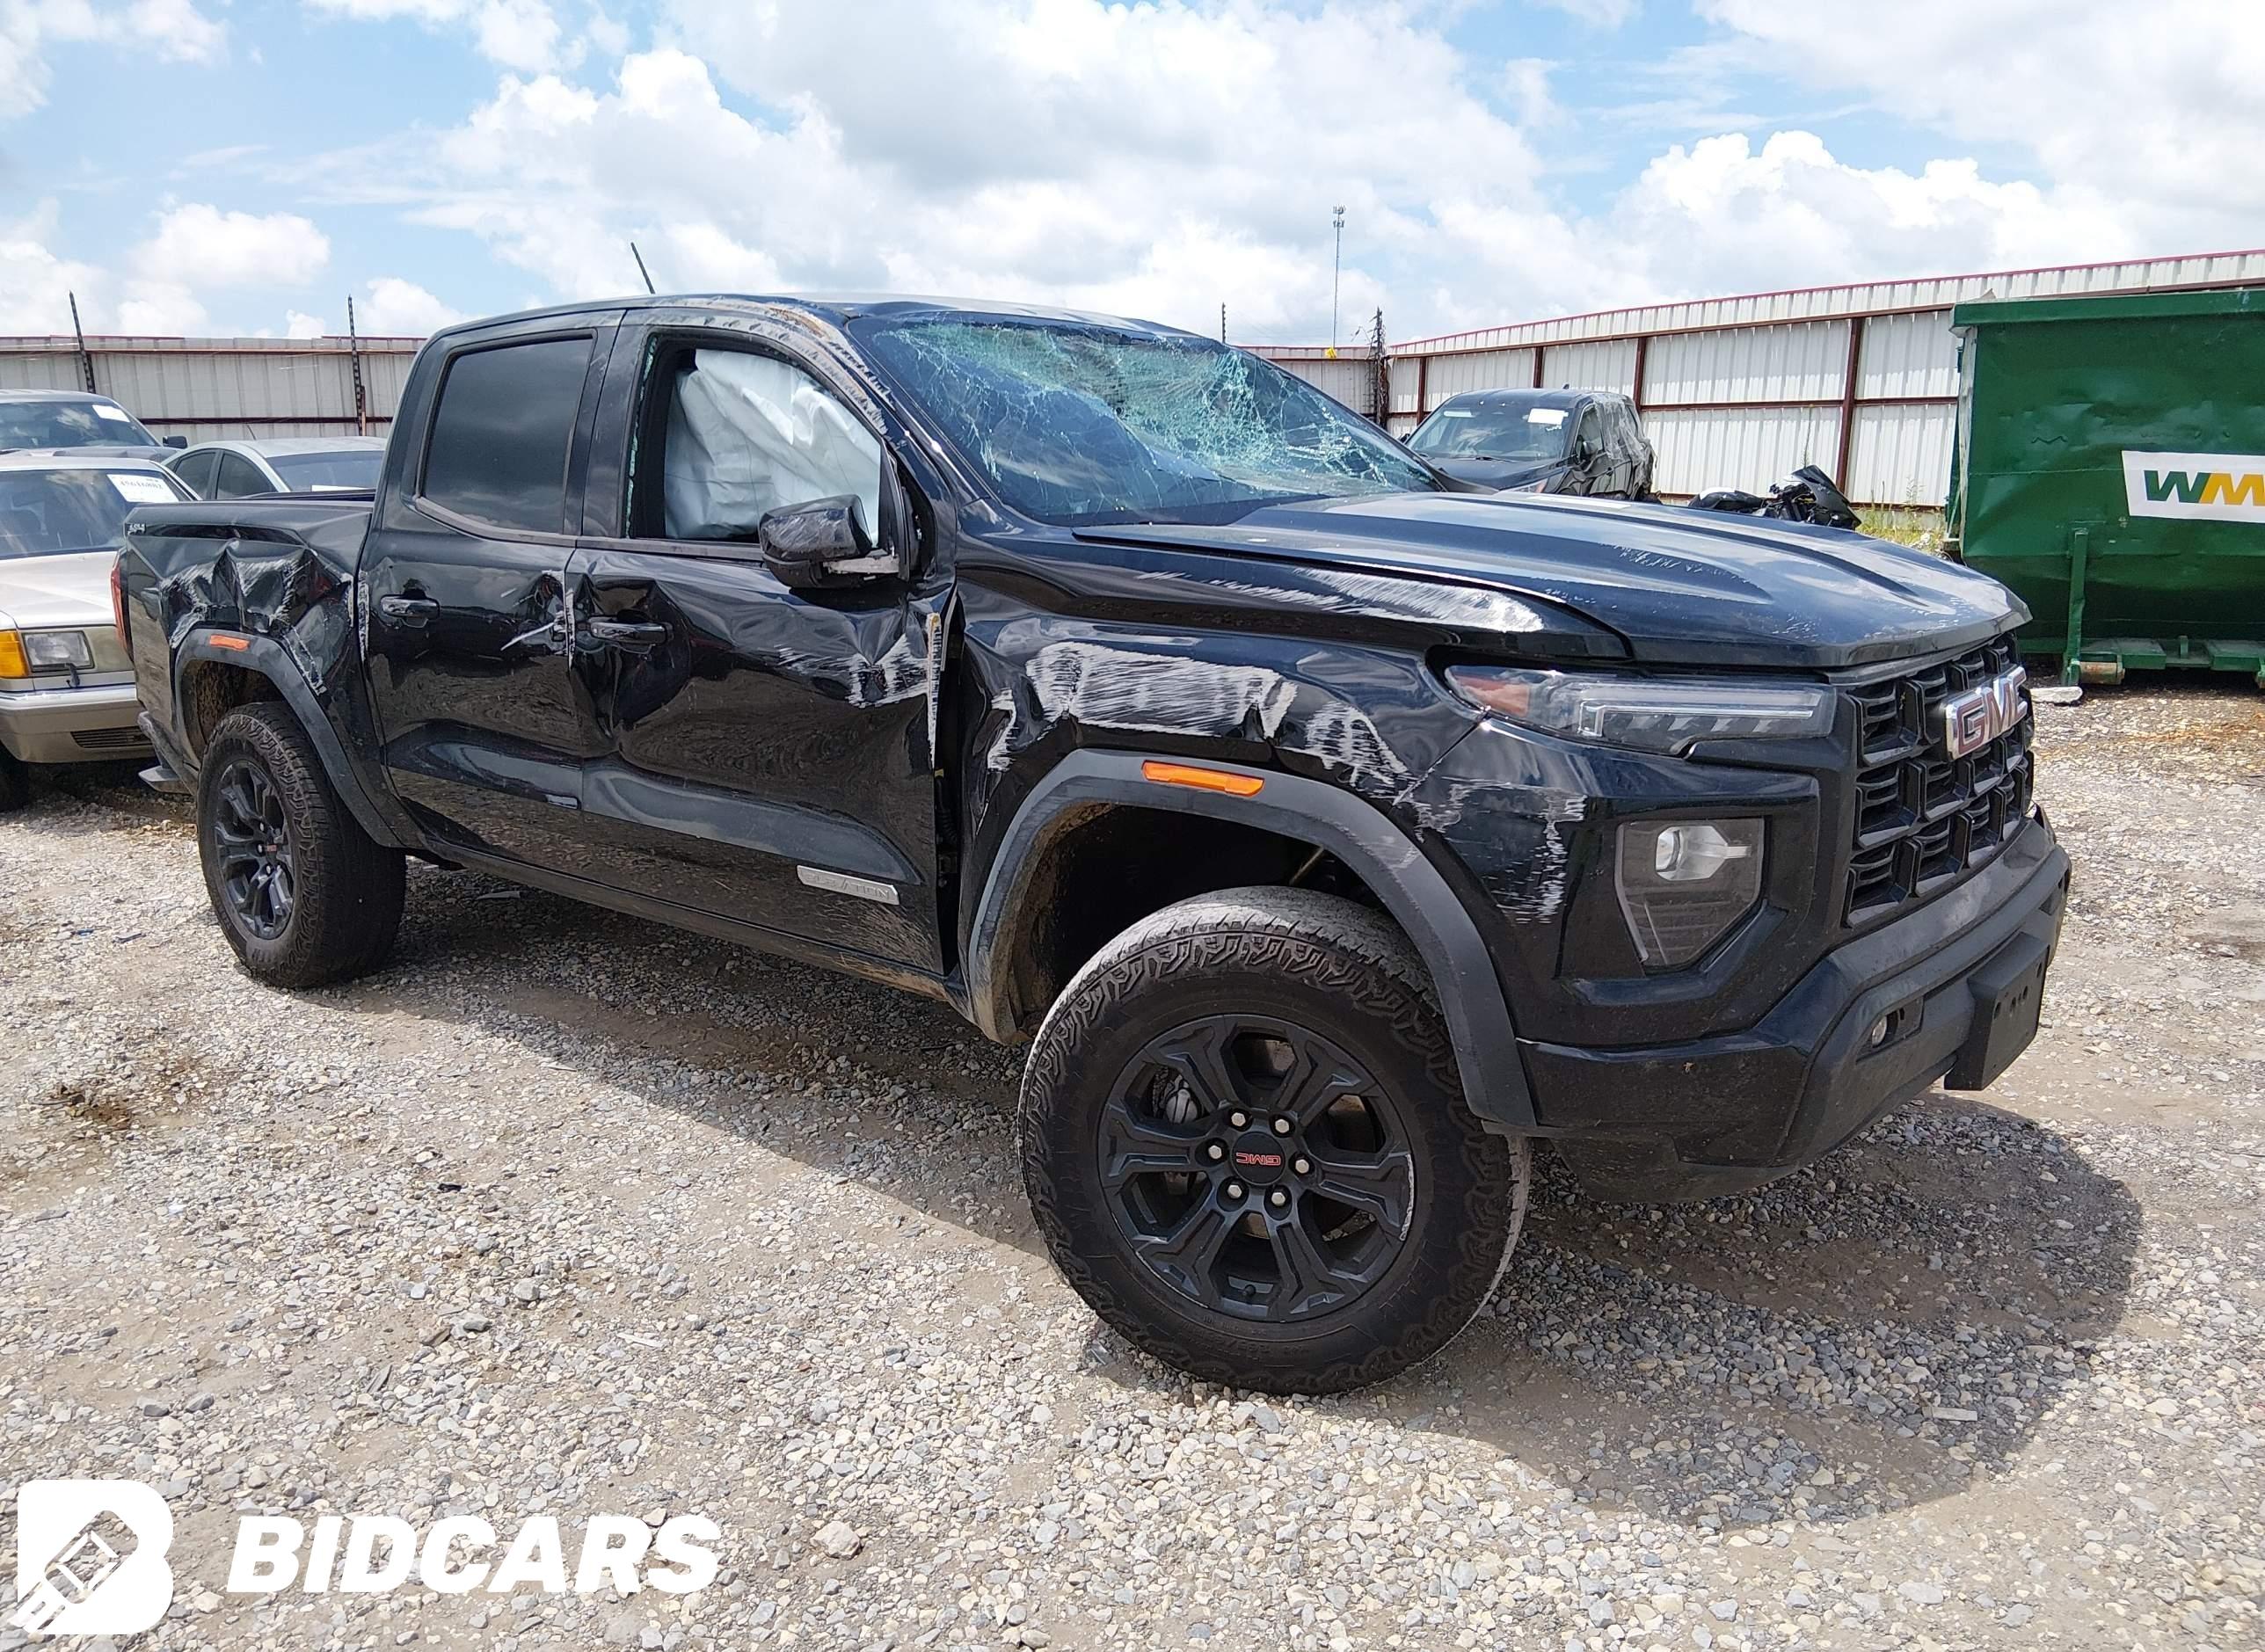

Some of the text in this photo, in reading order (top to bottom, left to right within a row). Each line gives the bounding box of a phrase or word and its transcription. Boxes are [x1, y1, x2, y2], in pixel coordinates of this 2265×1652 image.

[2144, 469, 2265, 506] WM
[1946, 666, 2028, 761] GMC
[1235, 1152, 1281, 1166] GMC
